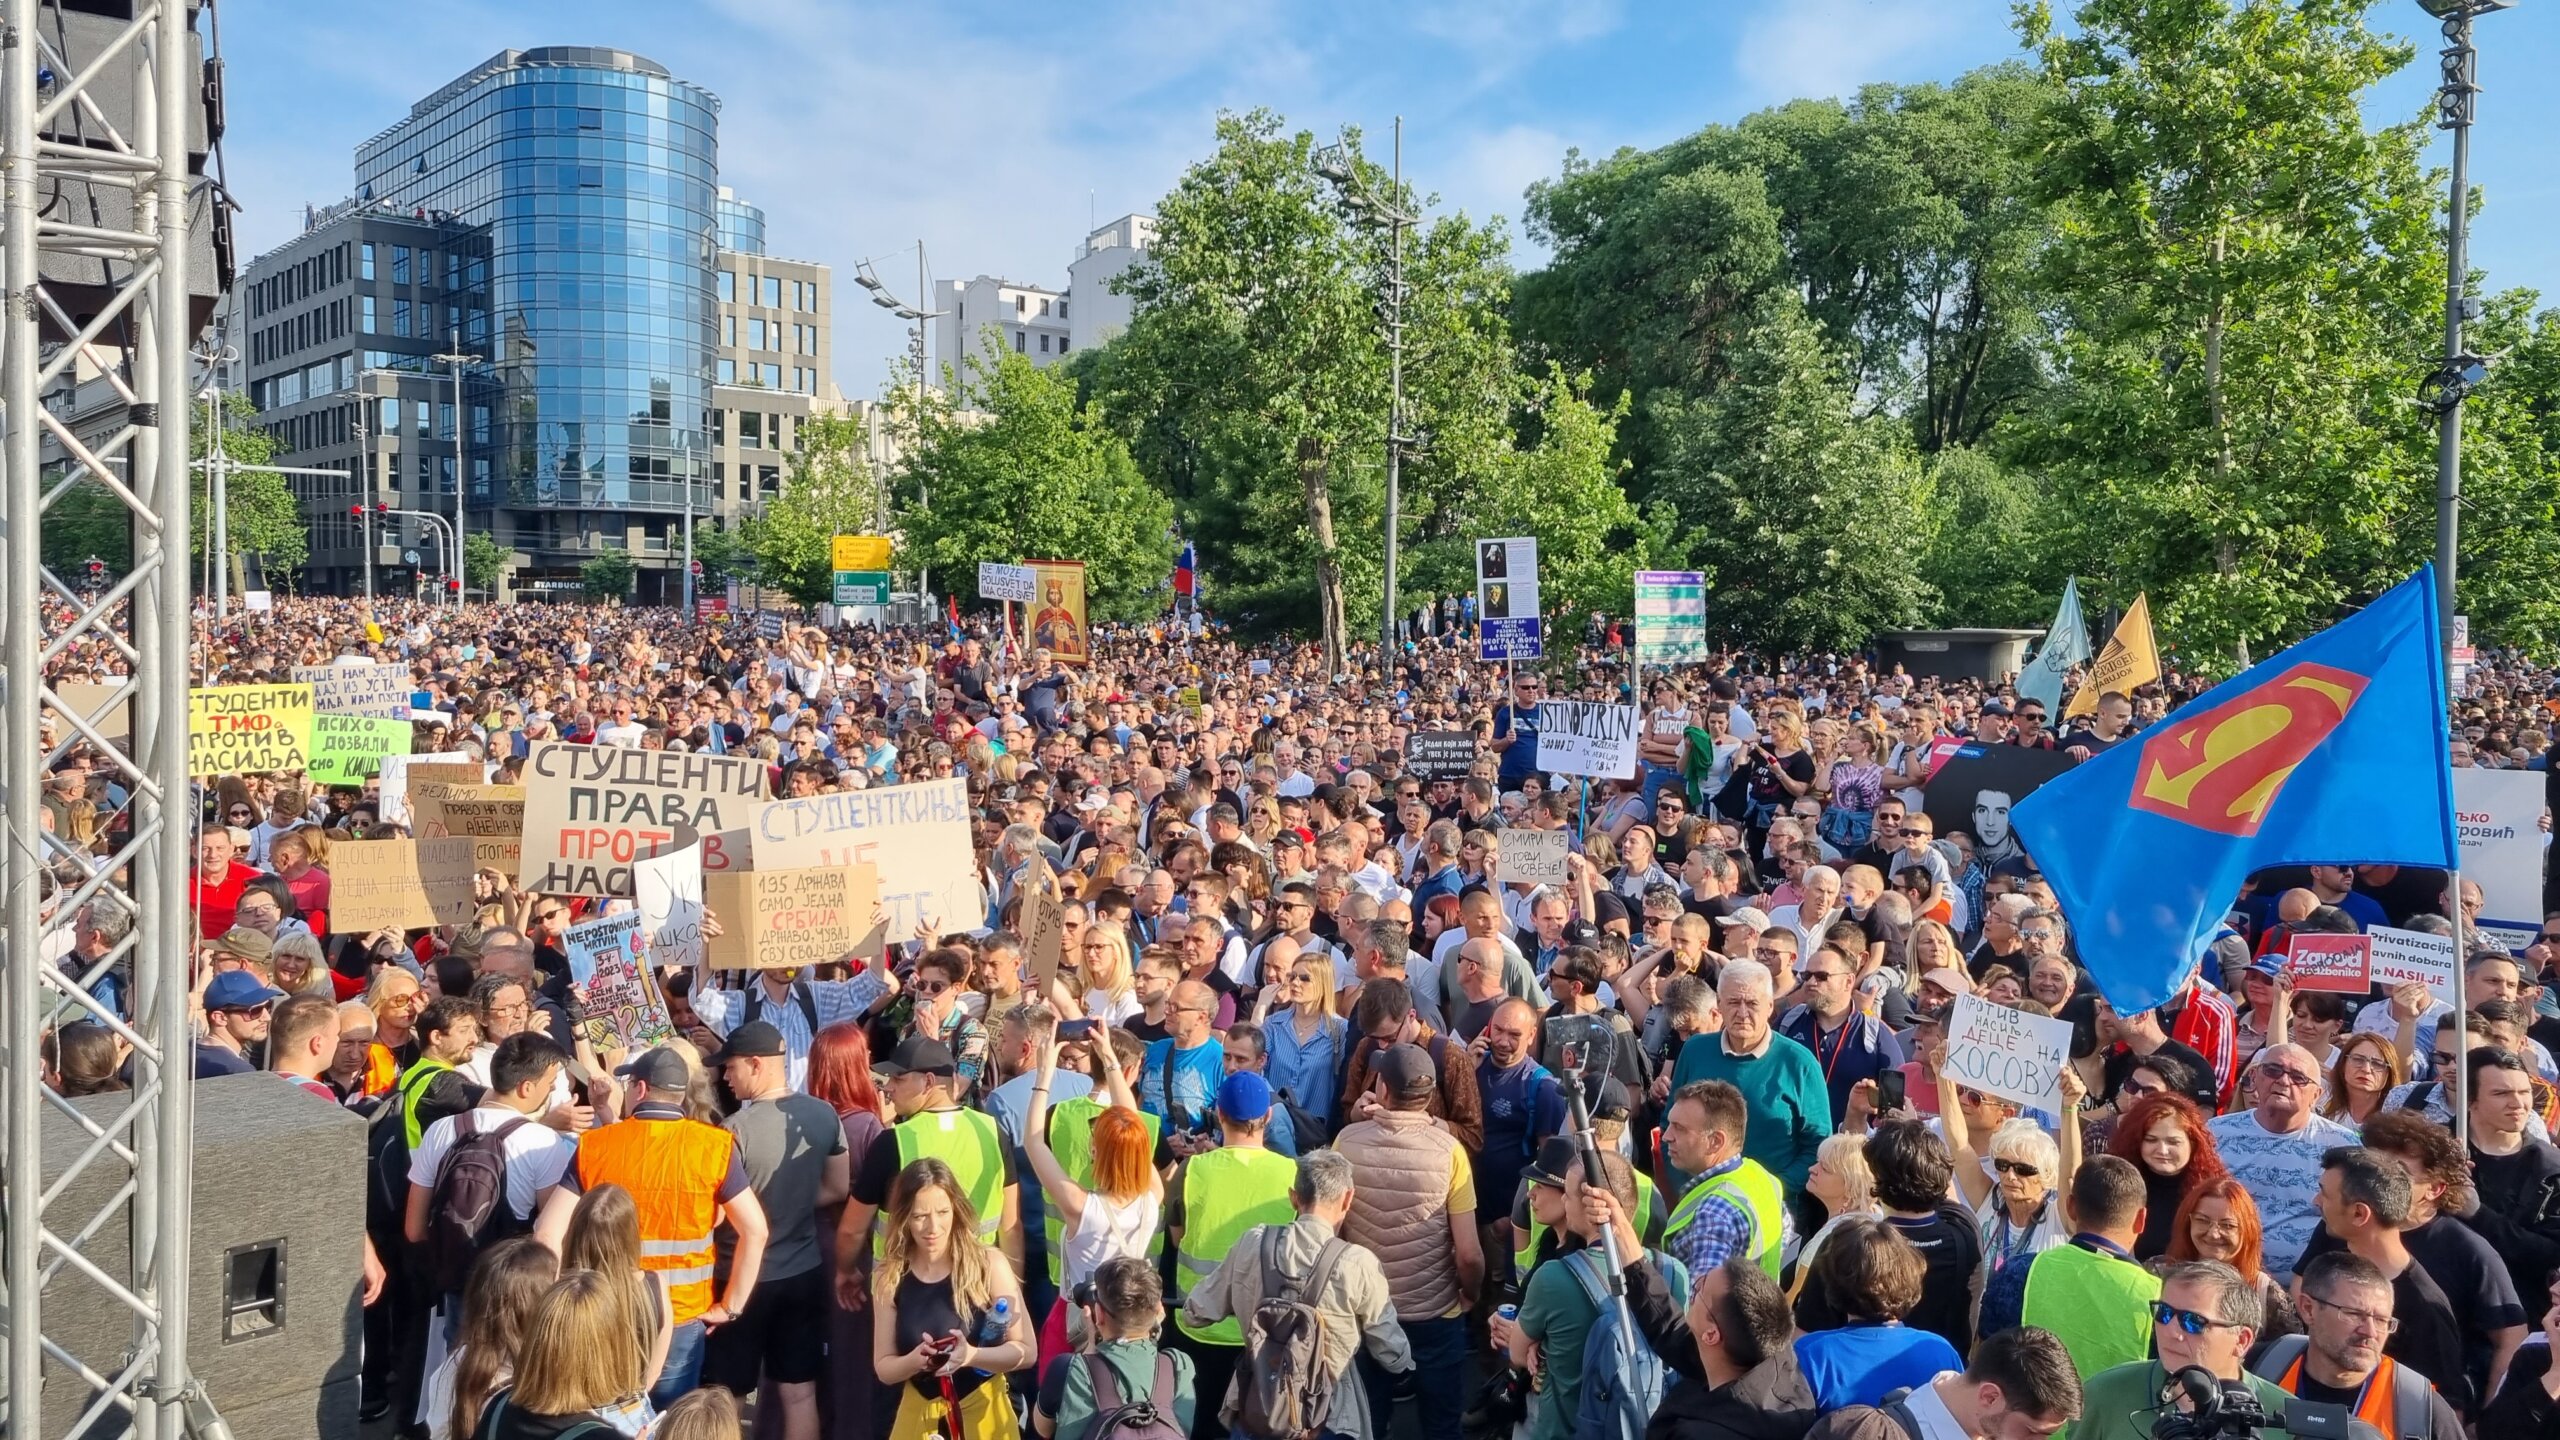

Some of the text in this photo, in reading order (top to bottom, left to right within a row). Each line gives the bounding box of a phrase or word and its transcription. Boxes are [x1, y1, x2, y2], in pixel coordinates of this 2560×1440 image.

[982, 564, 993, 574] NE
[982, 575, 1035, 590] POLUSVET DA
[982, 586, 1035, 601] IMA CEO SVET
[295, 665, 409, 683] КРШЕ НАМ УСТАВ
[344, 681, 358, 694] ИЗ
[366, 678, 395, 692] УСТА
[378, 691, 409, 703] ПУСТА
[1540, 702, 1634, 741] ISTINOPIRIN
[536, 745, 764, 797] СТУДЕНТИ
[1586, 760, 1591, 769] U
[418, 784, 477, 801] ЖЕЛИМО
[445, 804, 480, 815] ПРАВО
[484, 804, 497, 815] НА
[570, 787, 722, 830] ПРАВА
[760, 782, 970, 842] СТУДЕНТКИЊЕ
[477, 820, 493, 834] НЕ
[496, 820, 511, 833] НА
[559, 828, 730, 870] ПРОТВ
[1502, 832, 1565, 847] СМИРИ СЕ
[336, 846, 385, 868] ДОСТА
[1513, 860, 1561, 876] ЧОВЕЧЕ!
[336, 878, 379, 898] ЈЕДНА
[759, 872, 846, 894] 195 ДРЖАВА
[759, 892, 844, 912] САМО ЈЕДНА
[772, 910, 838, 930] СРБИЈА
[584, 934, 618, 952] MRTVIH
[815, 926, 849, 943] ЧУВАЈ
[760, 946, 785, 962] СВУ
[790, 943, 825, 960] СВОЈУ
[2372, 950, 2451, 969] avnih dobara
[599, 965, 621, 977] 2023
[2371, 965, 2445, 986] je NASILJE
[1961, 995, 2019, 1024] ПРОТИВ
[1962, 1026, 2018, 1051] ДЕЦЕ
[2037, 1044, 2061, 1065] НА
[1945, 1043, 2060, 1097] КОСОВУ
